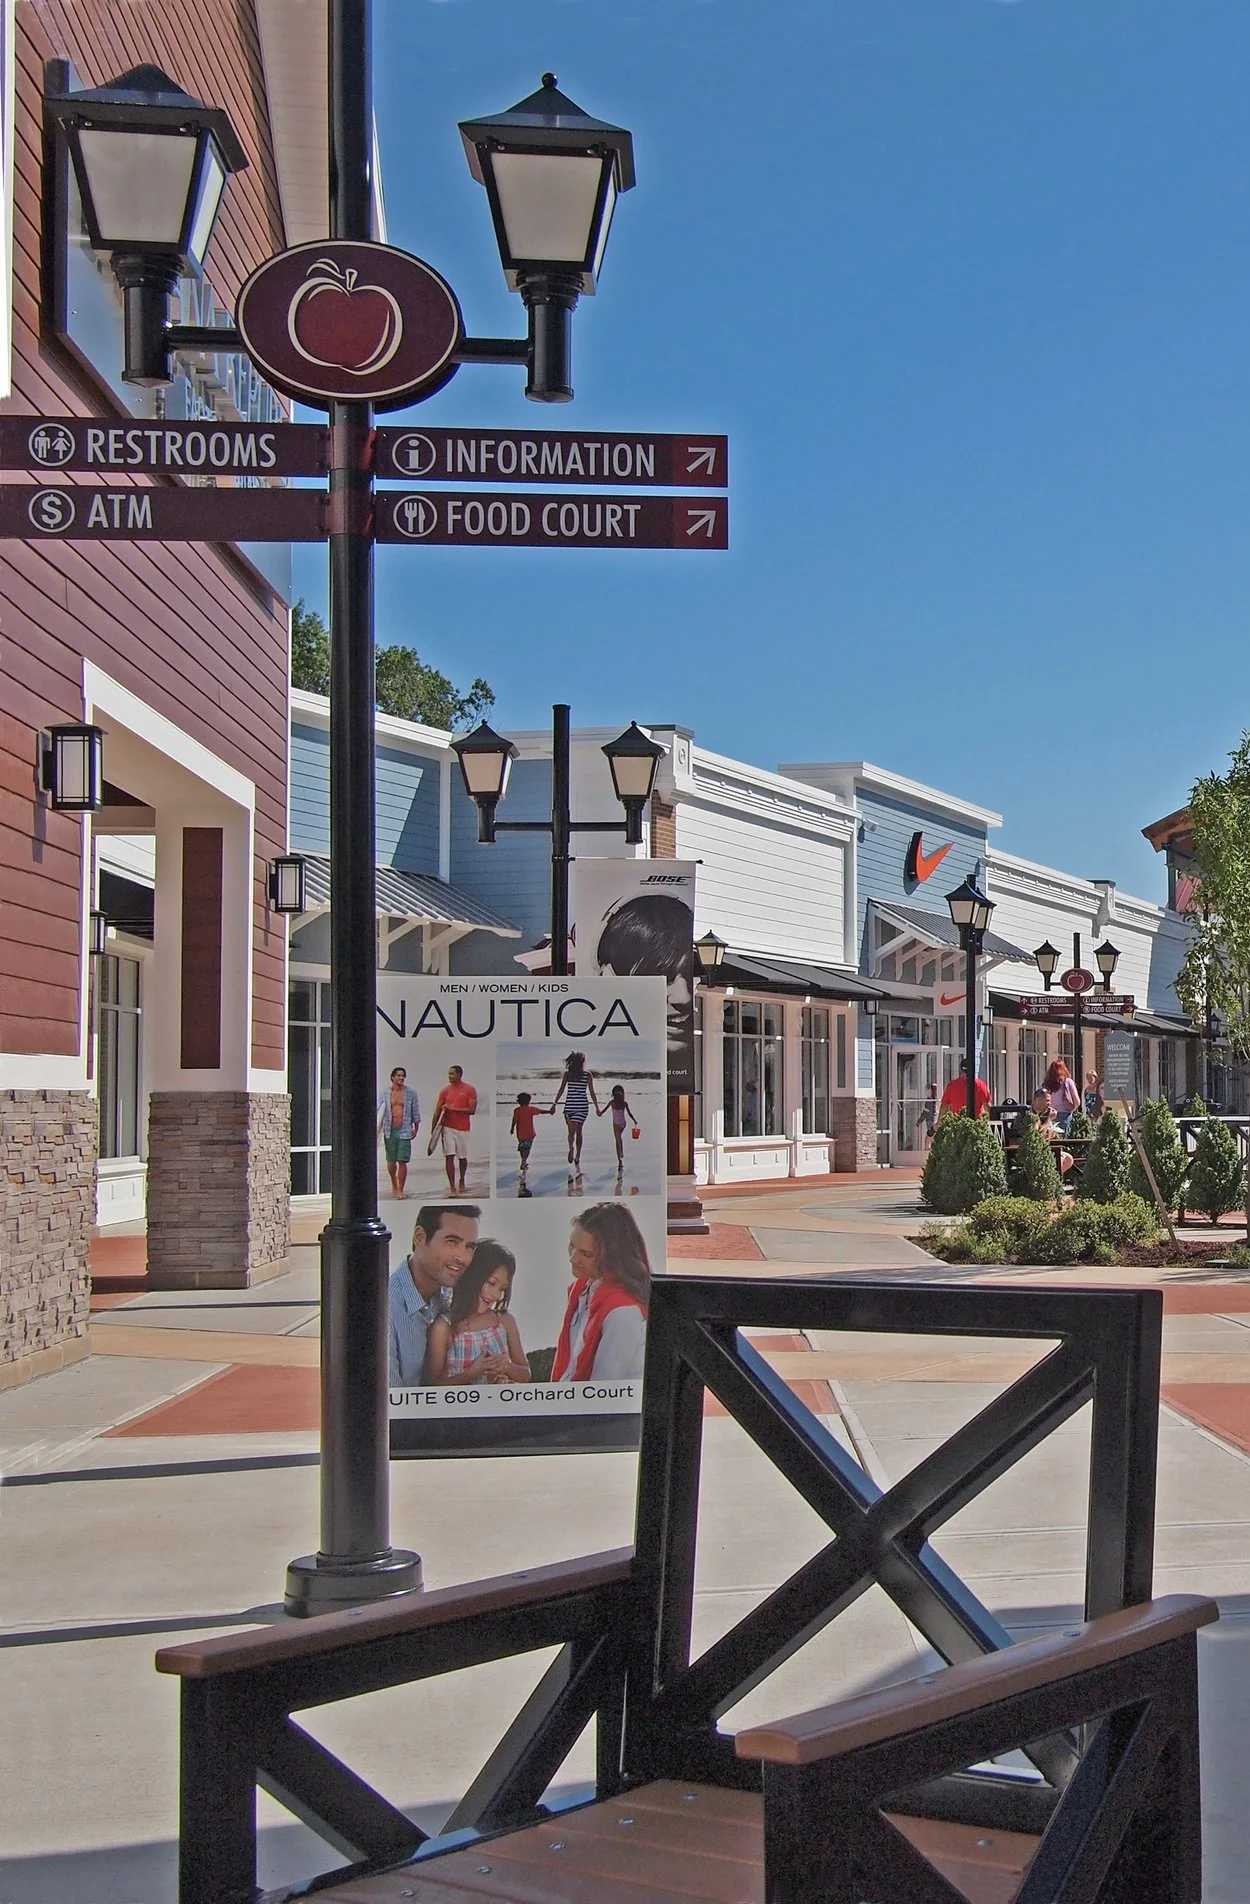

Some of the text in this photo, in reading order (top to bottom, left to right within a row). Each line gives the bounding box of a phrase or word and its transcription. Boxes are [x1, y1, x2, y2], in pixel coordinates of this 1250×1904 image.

[87, 428, 277, 468] RESTROOMS
[446, 438, 655, 477] INFORMATION
[87, 494, 153, 529] ATM
[447, 500, 641, 538] FOOD COURT
[640, 875, 692, 883] BOSE
[440, 984, 468, 993] MEN
[480, 984, 528, 993] WOMEN
[538, 983, 569, 993] KIDS
[377, 998, 640, 1038] NAUTICA
[1106, 1043, 1131, 1051] WELCOME
[389, 1391, 437, 1406] UITE
[444, 1390, 481, 1404] 609
[499, 1387, 575, 1402] Orchard
[582, 1385, 634, 1399] Court
